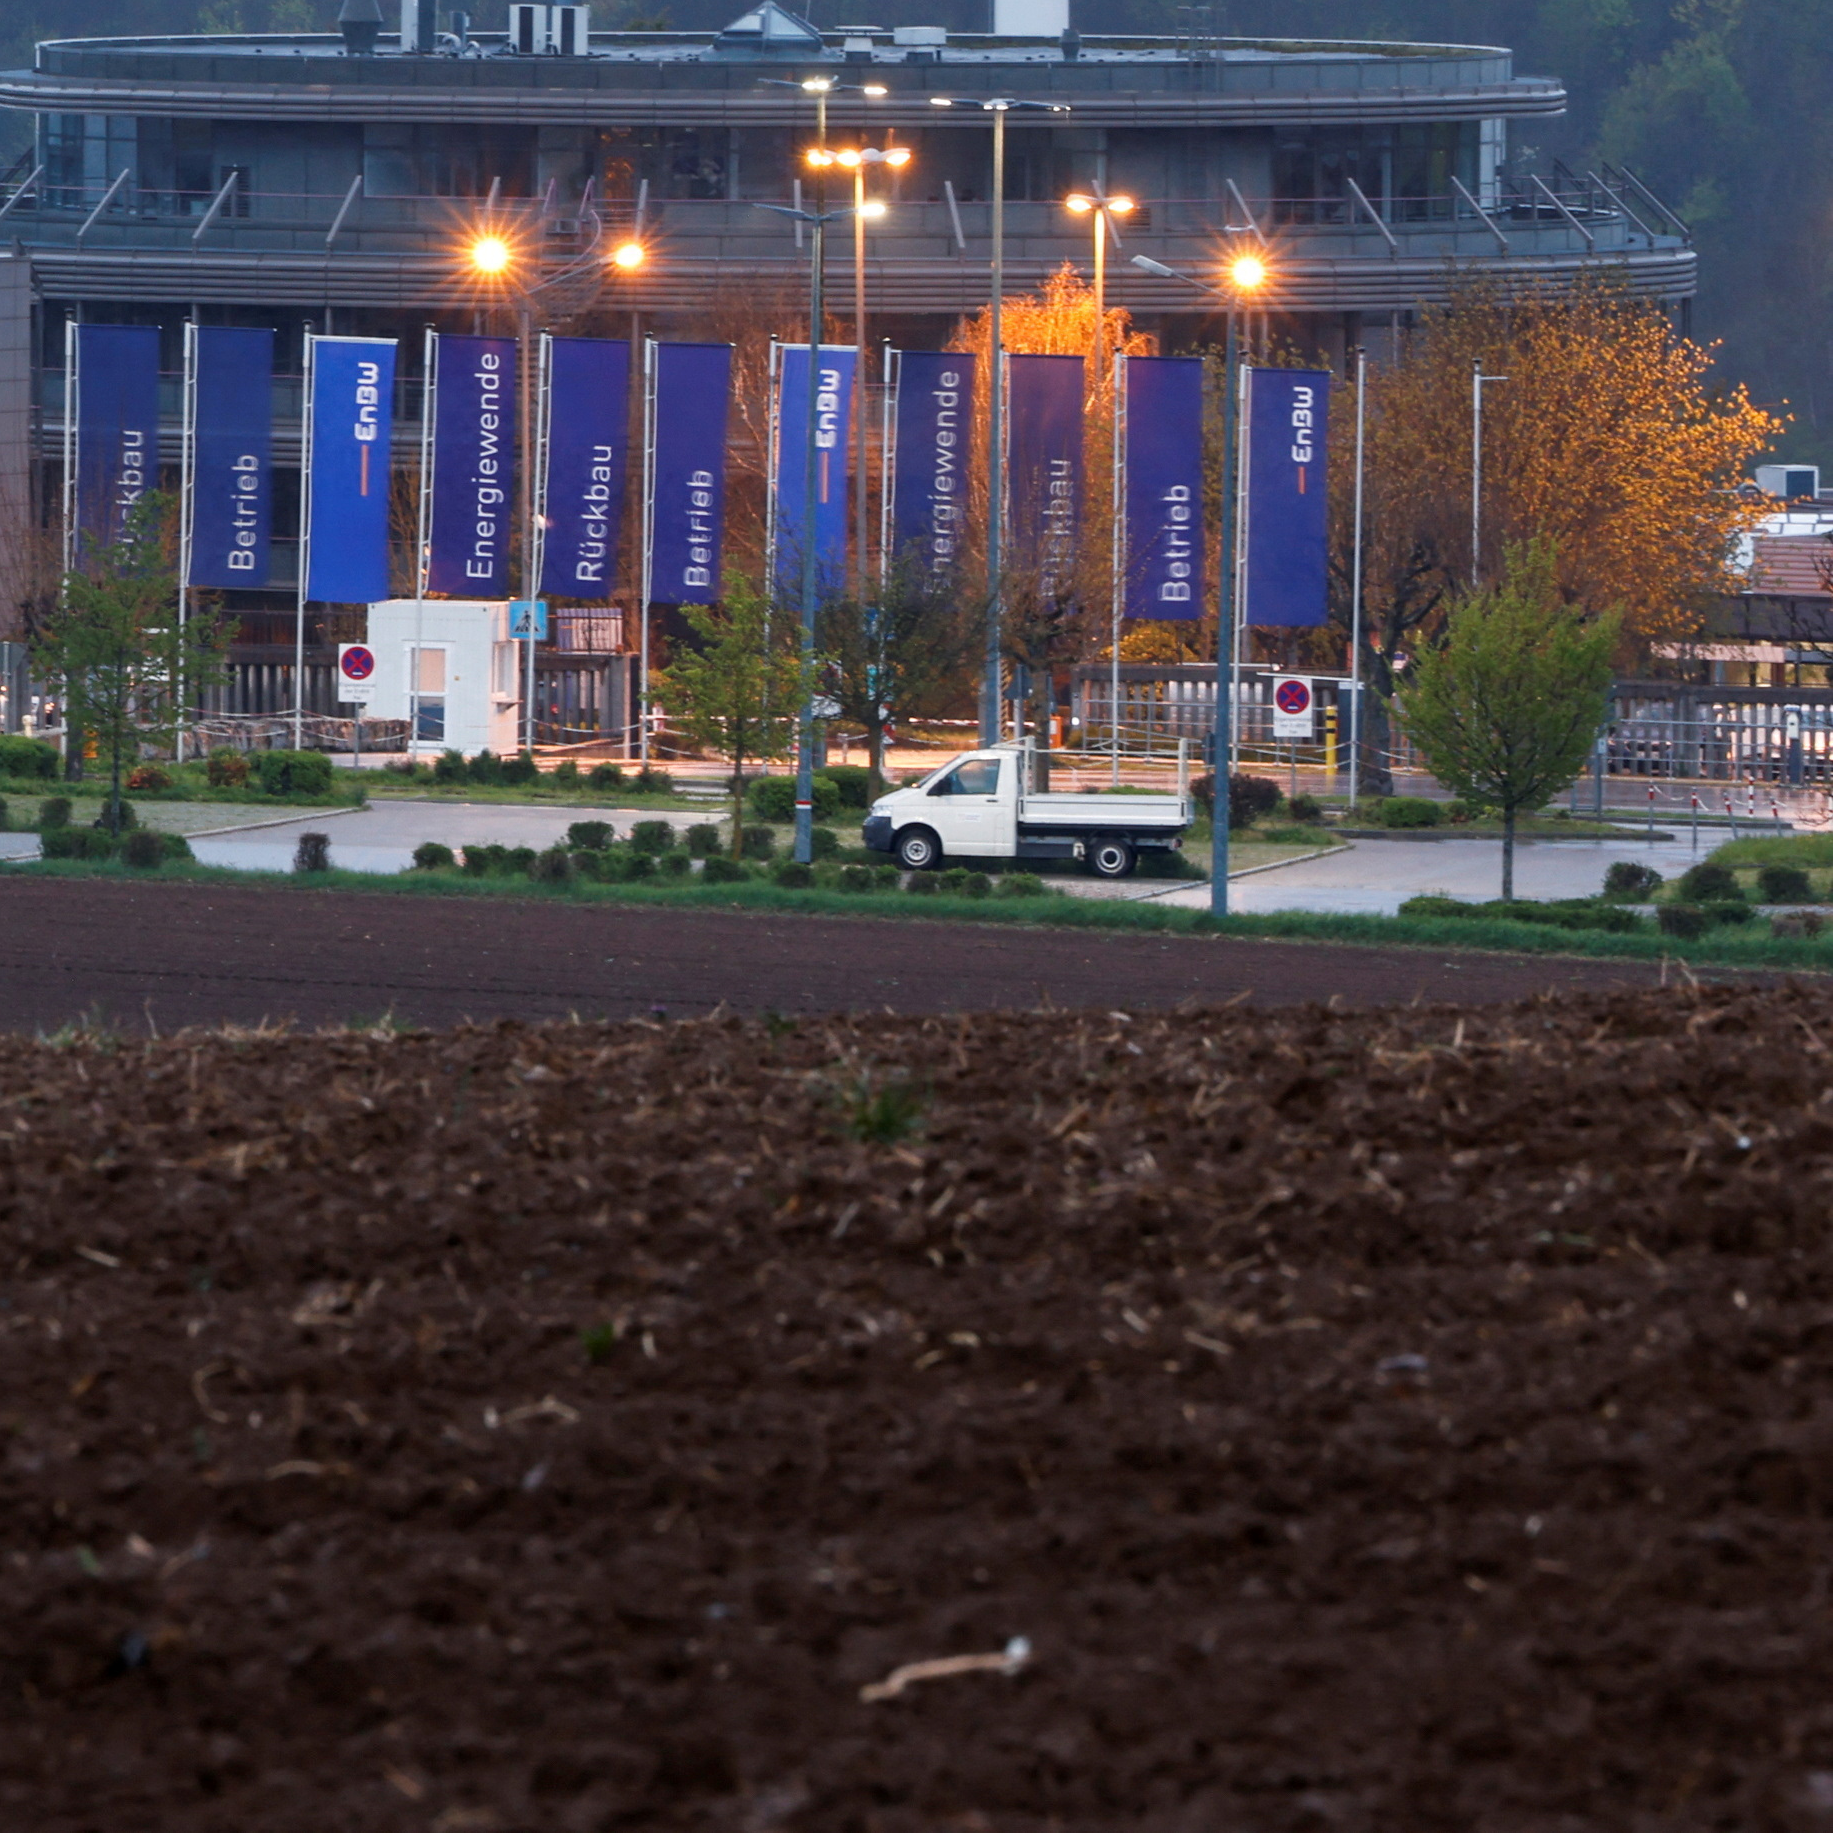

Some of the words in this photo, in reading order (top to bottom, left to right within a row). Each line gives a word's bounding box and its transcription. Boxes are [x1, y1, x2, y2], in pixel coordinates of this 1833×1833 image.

[354, 361, 380, 442] EnBW
[814, 368, 841, 448] EnBW
[1291, 385, 1314, 463] EnBW
[227, 454, 259, 570] Betrieb
[465, 353, 504, 579] Energiewende
[575, 445, 612, 581] Rückbau
[683, 469, 714, 587] Betrieb
[1158, 484, 1192, 602] Betrieb
